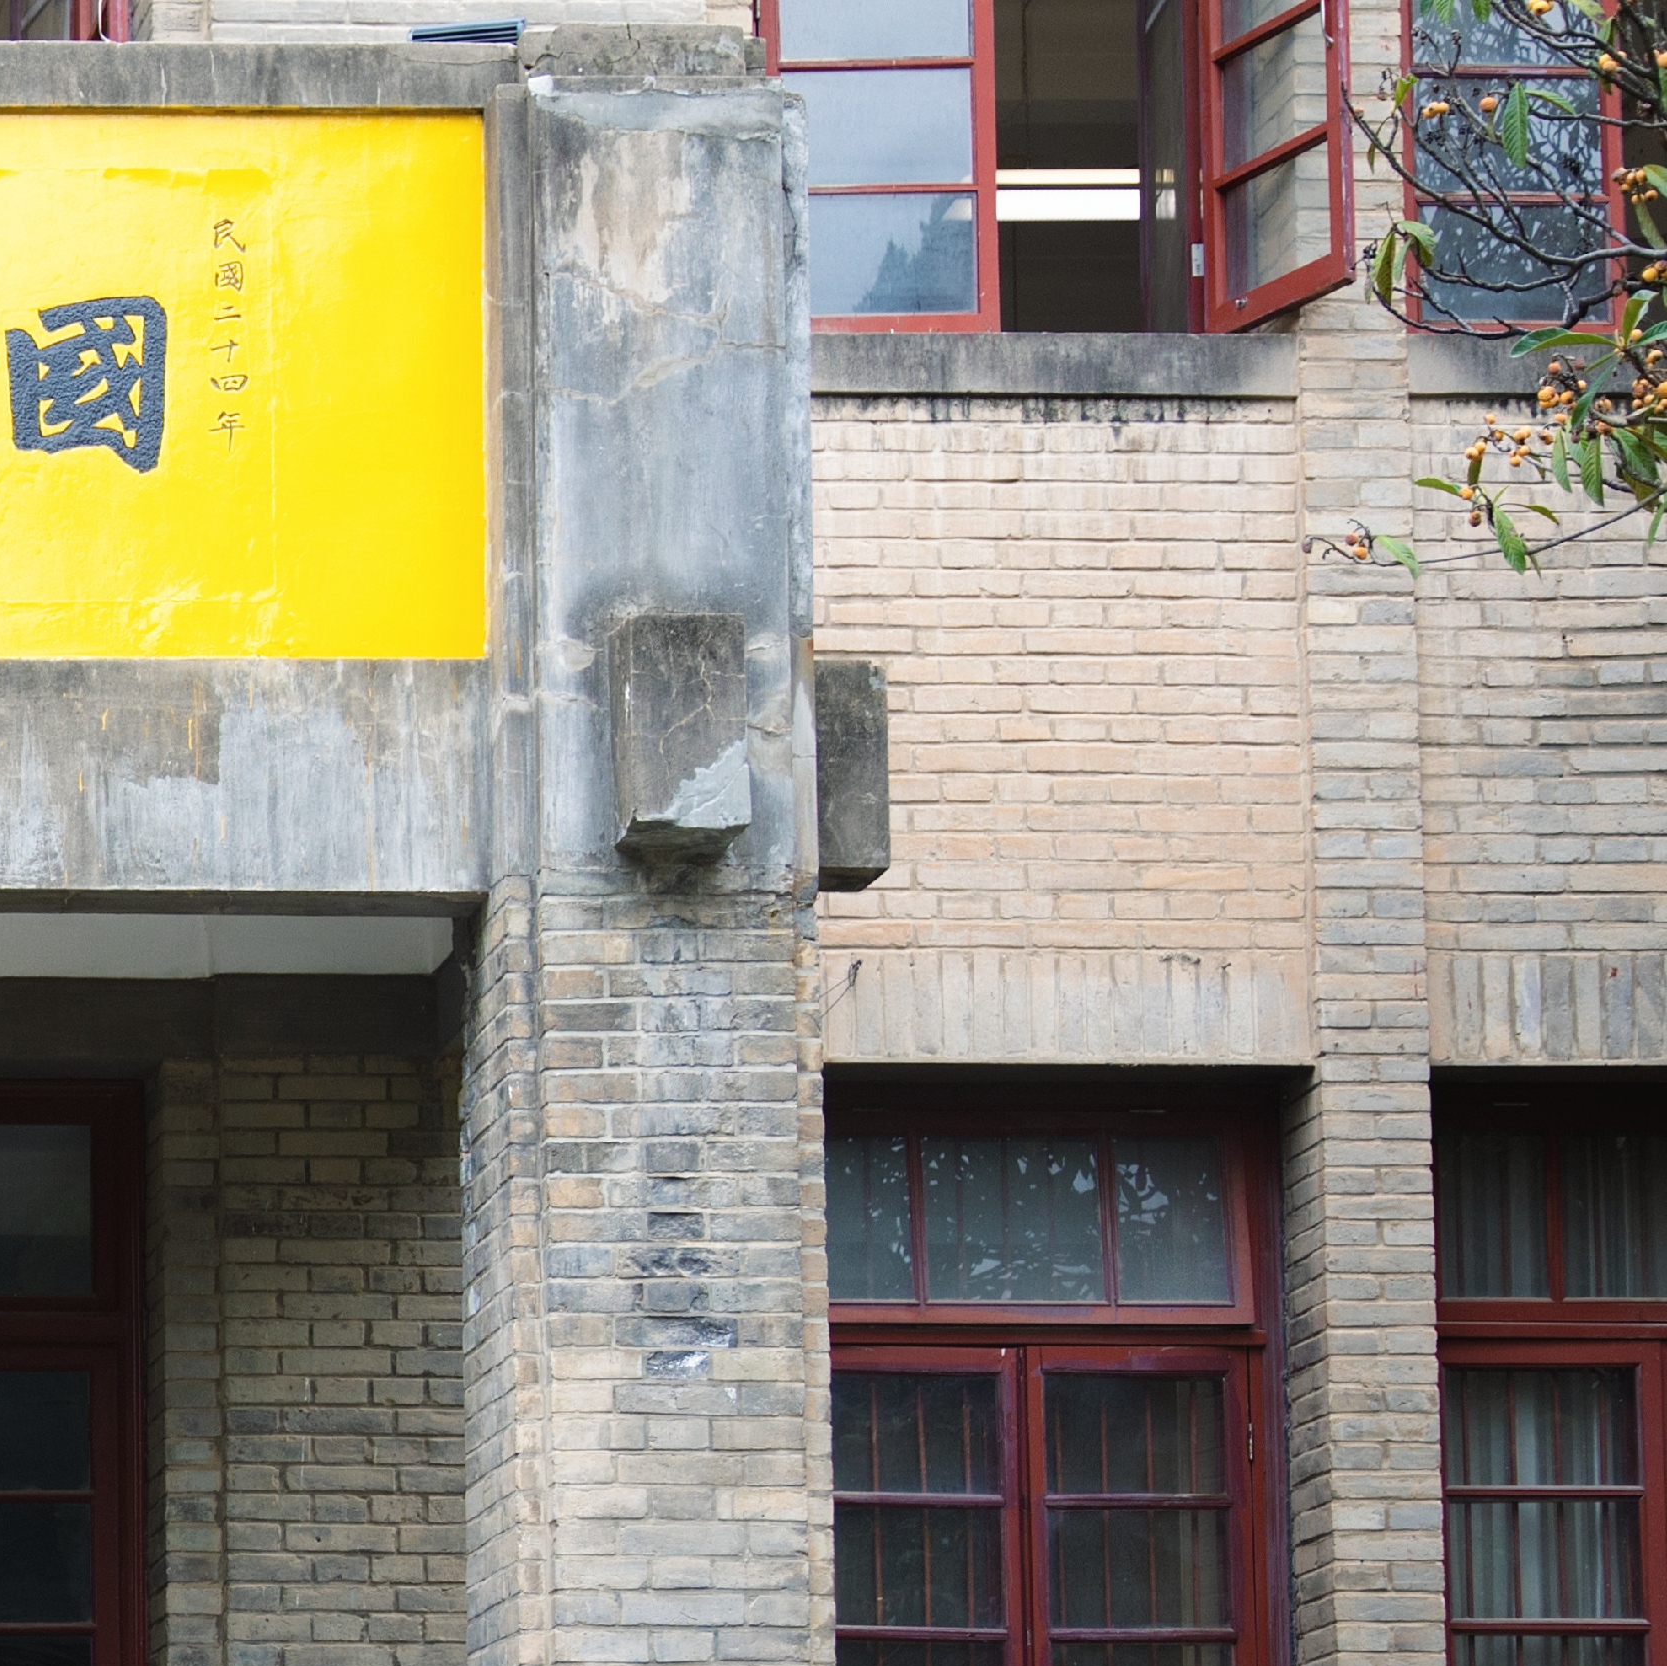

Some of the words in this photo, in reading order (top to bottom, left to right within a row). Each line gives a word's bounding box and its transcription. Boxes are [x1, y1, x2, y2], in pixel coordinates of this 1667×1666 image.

[208, 217, 249, 453] 民國二十四年
